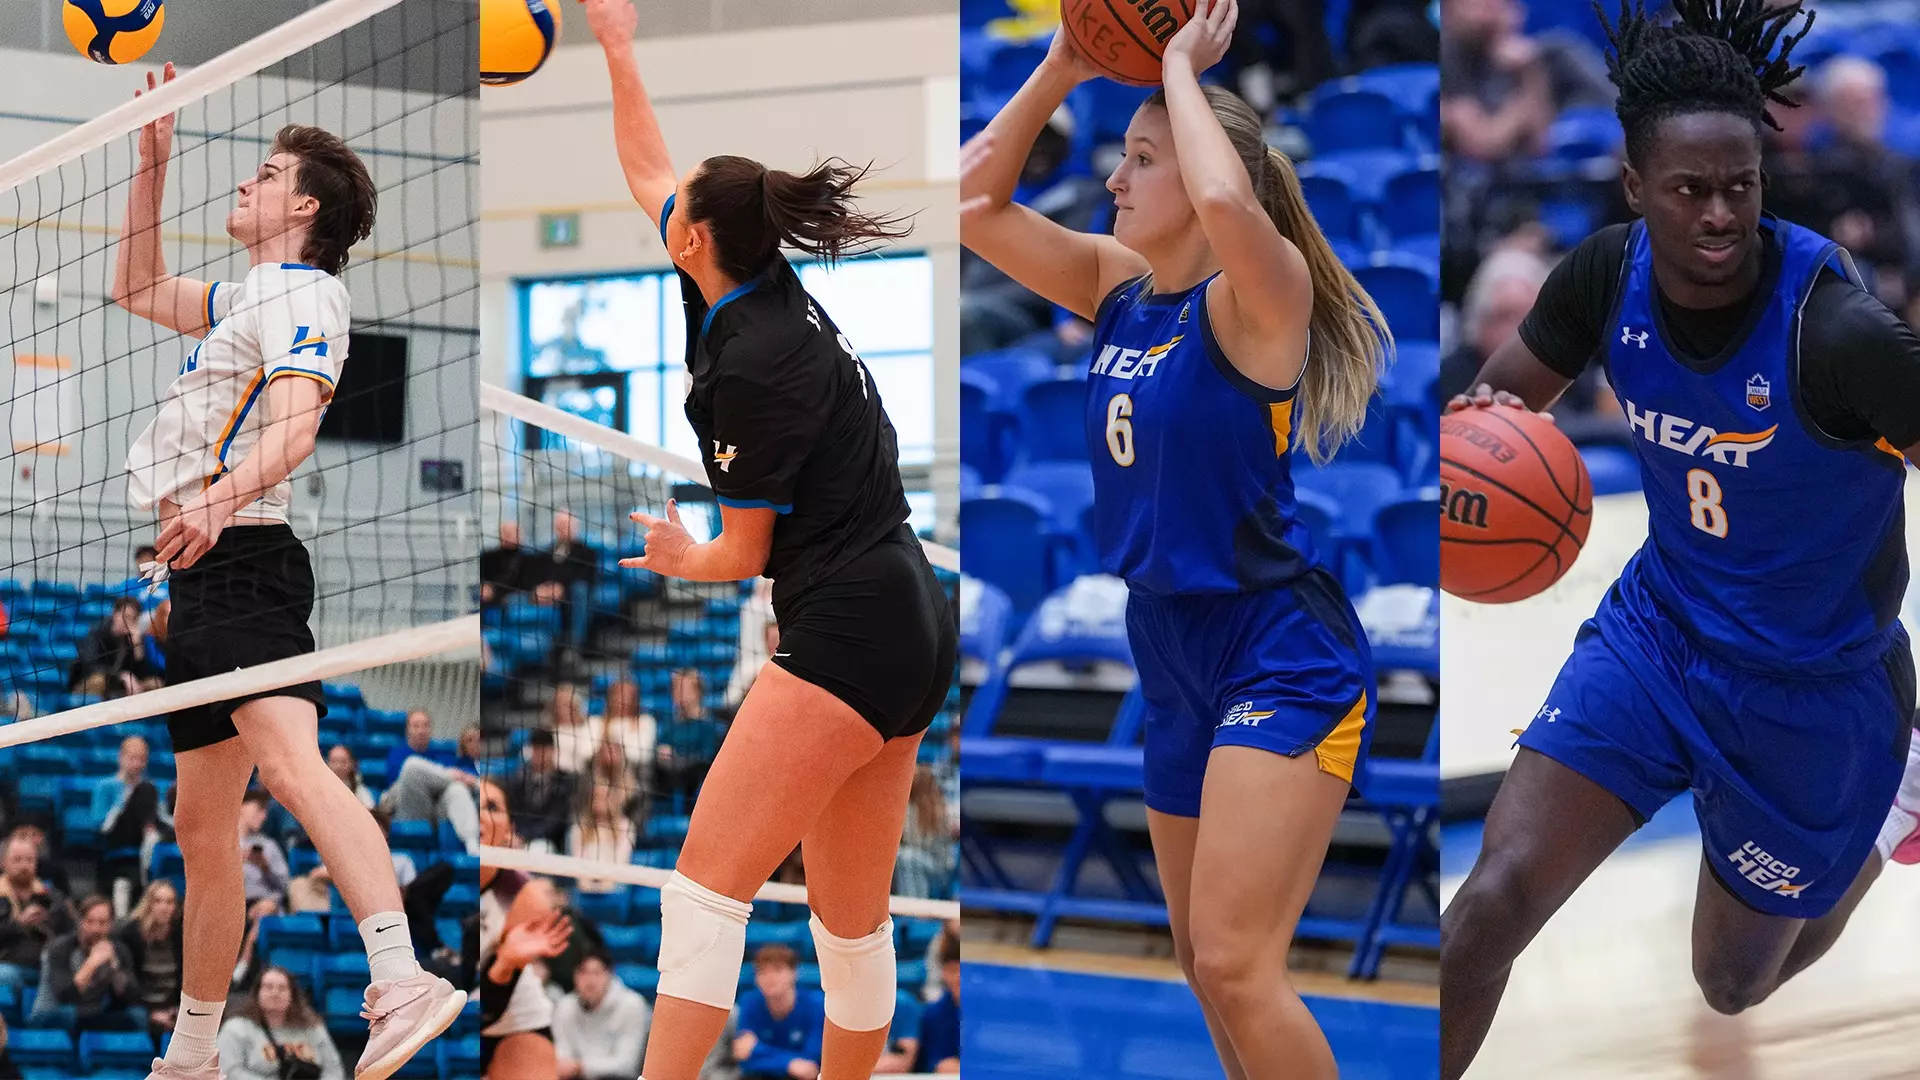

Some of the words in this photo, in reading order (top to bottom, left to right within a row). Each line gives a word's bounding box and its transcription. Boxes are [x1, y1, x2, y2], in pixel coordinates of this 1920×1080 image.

[1106, 393, 1135, 468] 6
[1625, 398, 1779, 468] HEAT
[1749, 395, 1767, 405] WEST
[1686, 467, 1729, 539] 8
[1742, 840, 1800, 879] UBCO
